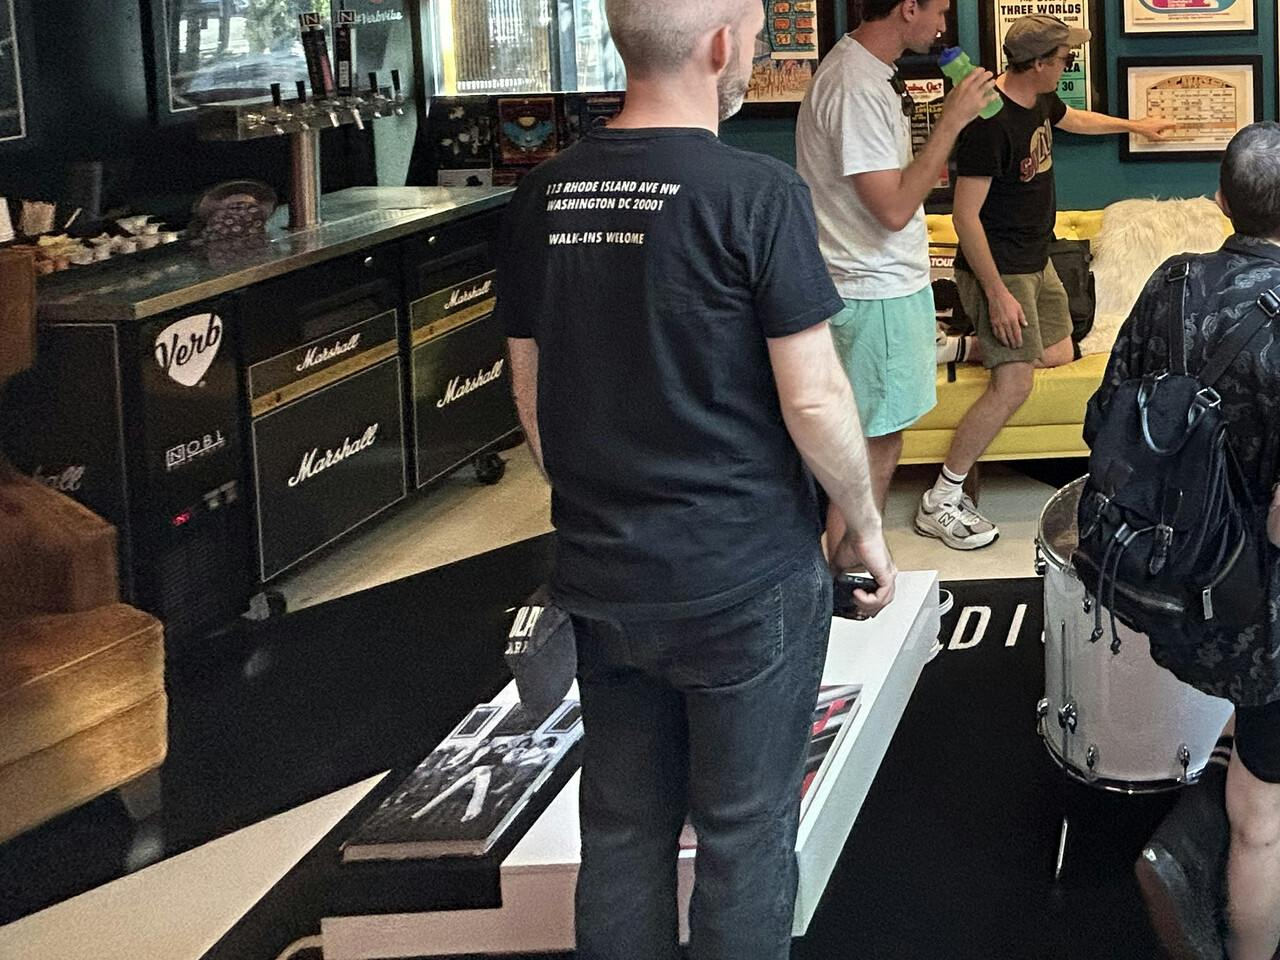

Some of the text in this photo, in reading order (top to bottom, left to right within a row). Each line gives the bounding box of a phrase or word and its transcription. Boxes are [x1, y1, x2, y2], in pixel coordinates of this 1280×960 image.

[1001, 4, 1081, 15] THREE WORLDS
[1062, 81, 1074, 91] 30
[546, 181, 680, 196] 113 RHODE ISLAND AVE NW
[546, 198, 616, 211] WASHINGTON
[618, 198, 631, 209] DC
[549, 232, 603, 245] WALK-INS
[444, 280, 493, 310] Marshall
[156, 313, 220, 375] Verb
[296, 332, 361, 371] Marshall
[436, 358, 504, 408] Marshall
[288, 423, 379, 487] Marshall
